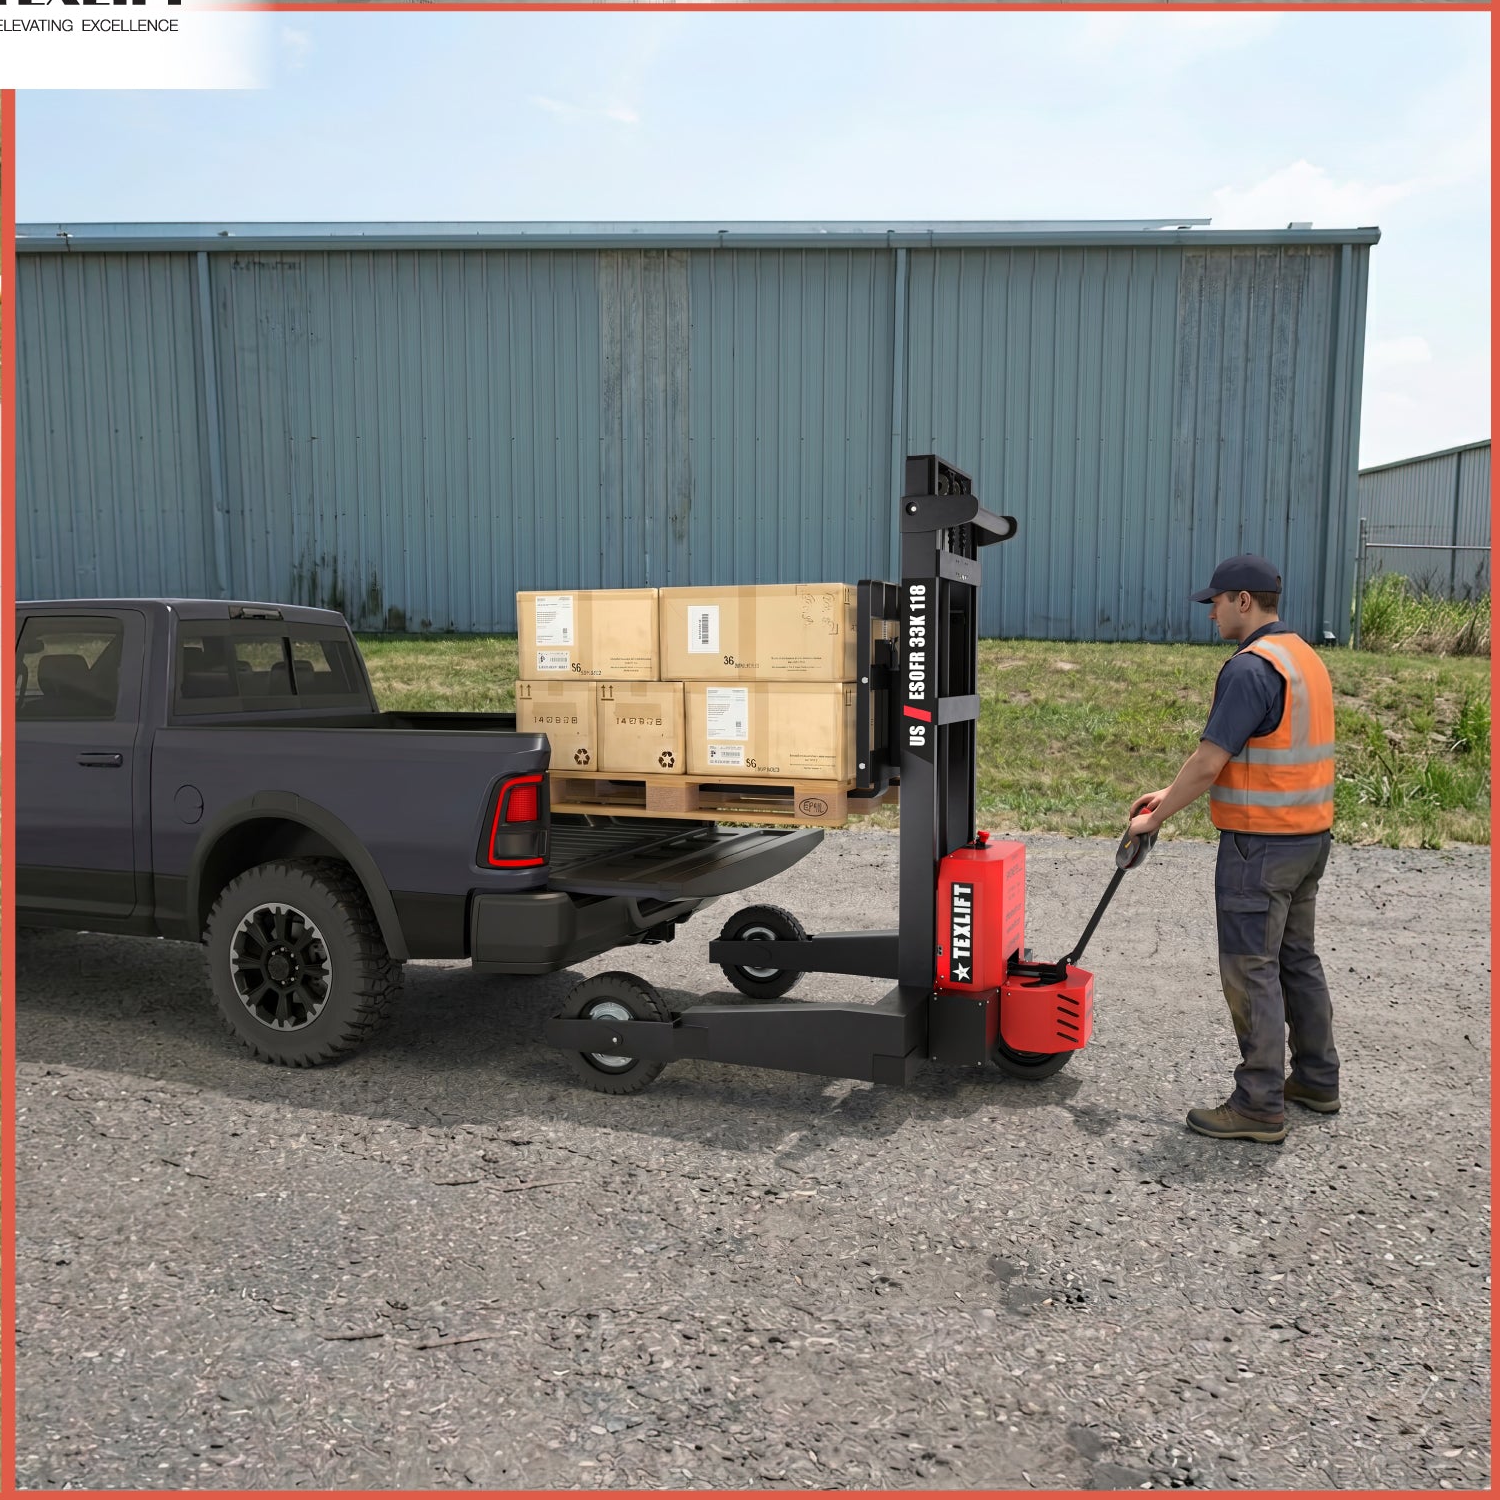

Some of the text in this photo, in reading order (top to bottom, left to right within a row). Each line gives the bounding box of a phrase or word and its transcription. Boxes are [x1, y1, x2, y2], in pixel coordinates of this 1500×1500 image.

[908, 584, 926, 747] US ESOFR 33K 118
[953, 885, 971, 958] TEXLIFT
